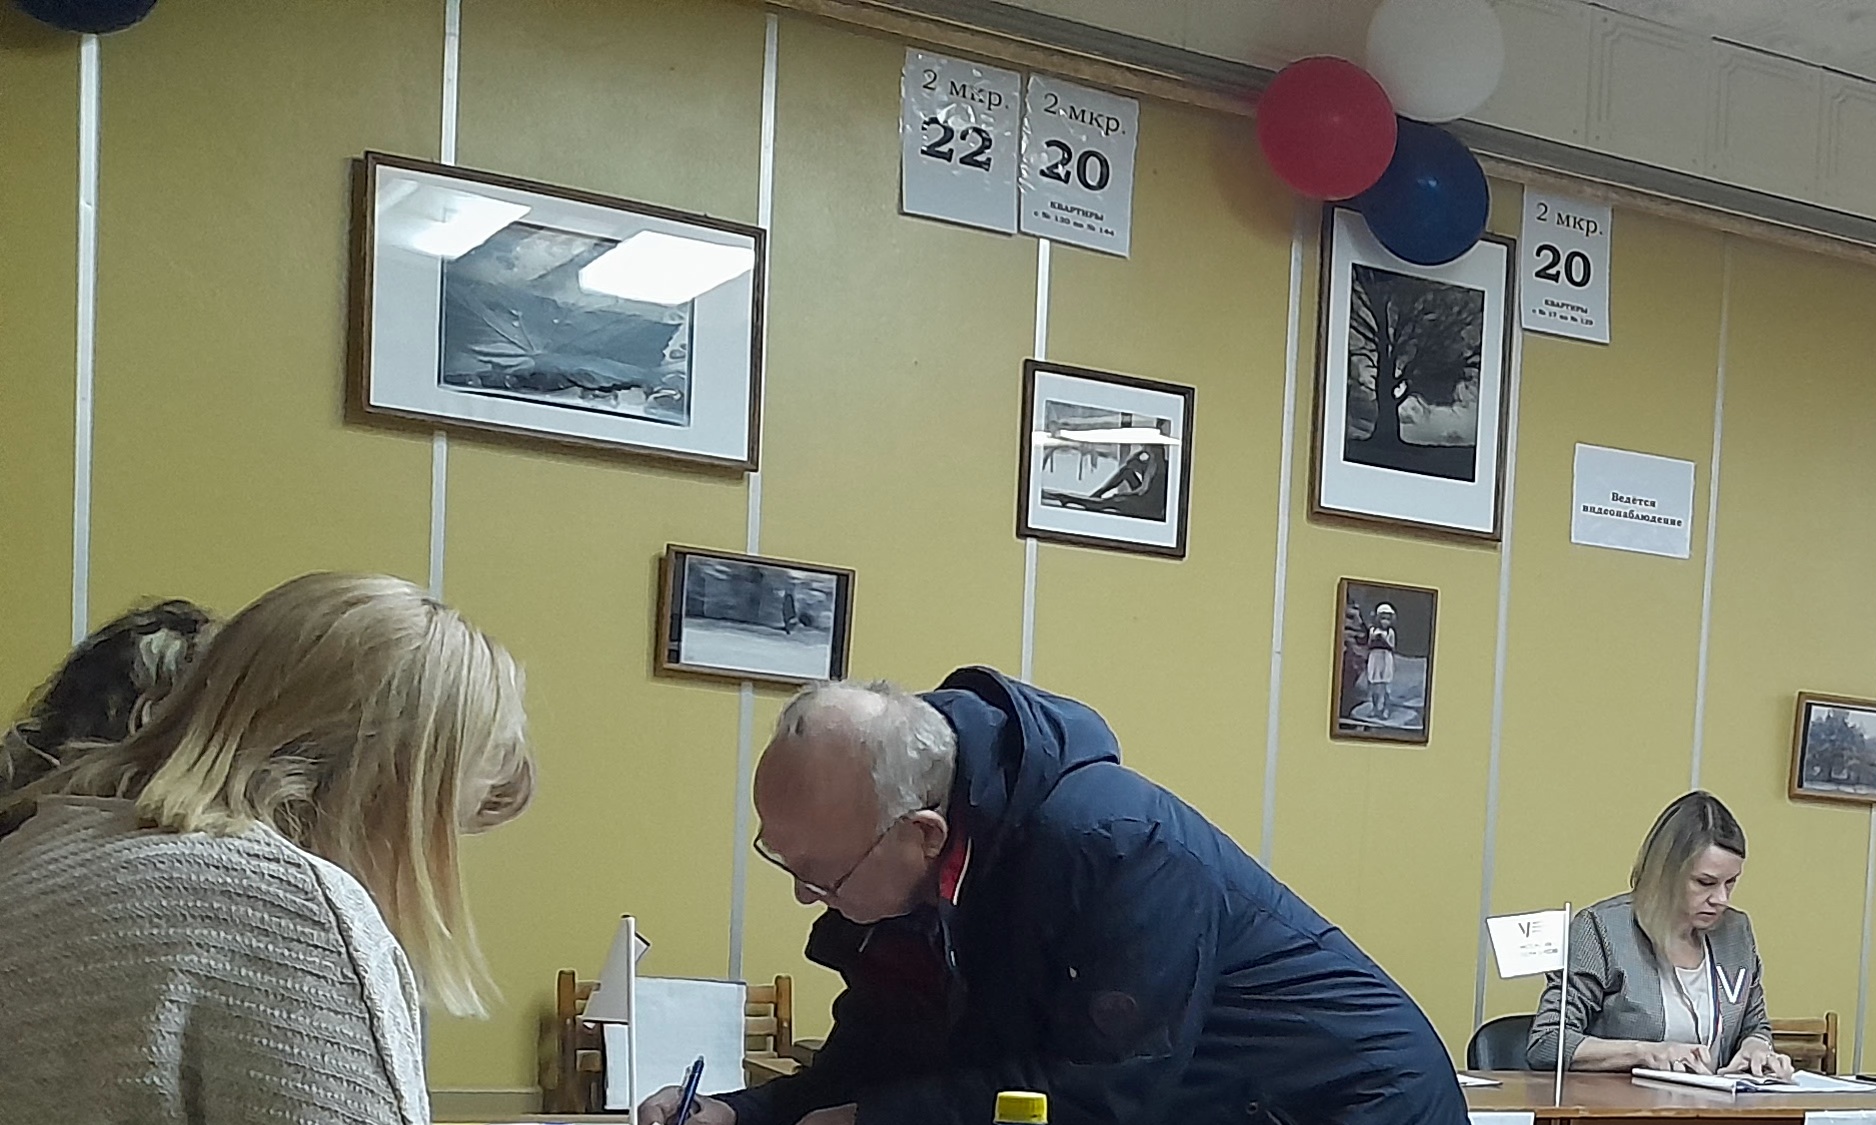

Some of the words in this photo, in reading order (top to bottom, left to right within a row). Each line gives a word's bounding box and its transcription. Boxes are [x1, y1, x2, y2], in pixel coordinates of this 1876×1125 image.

[923, 69, 937, 90] 2
[1044, 93, 1058, 114] 2
[1069, 105, 1126, 135] мкр.
[921, 116, 992, 172] 22
[1039, 139, 1110, 191] 20
[1536, 203, 1548, 222] 2
[1556, 212, 1603, 237] мкр.
[1534, 244, 1591, 288] 20
[1582, 504, 1682, 527] видеонаблюдение
